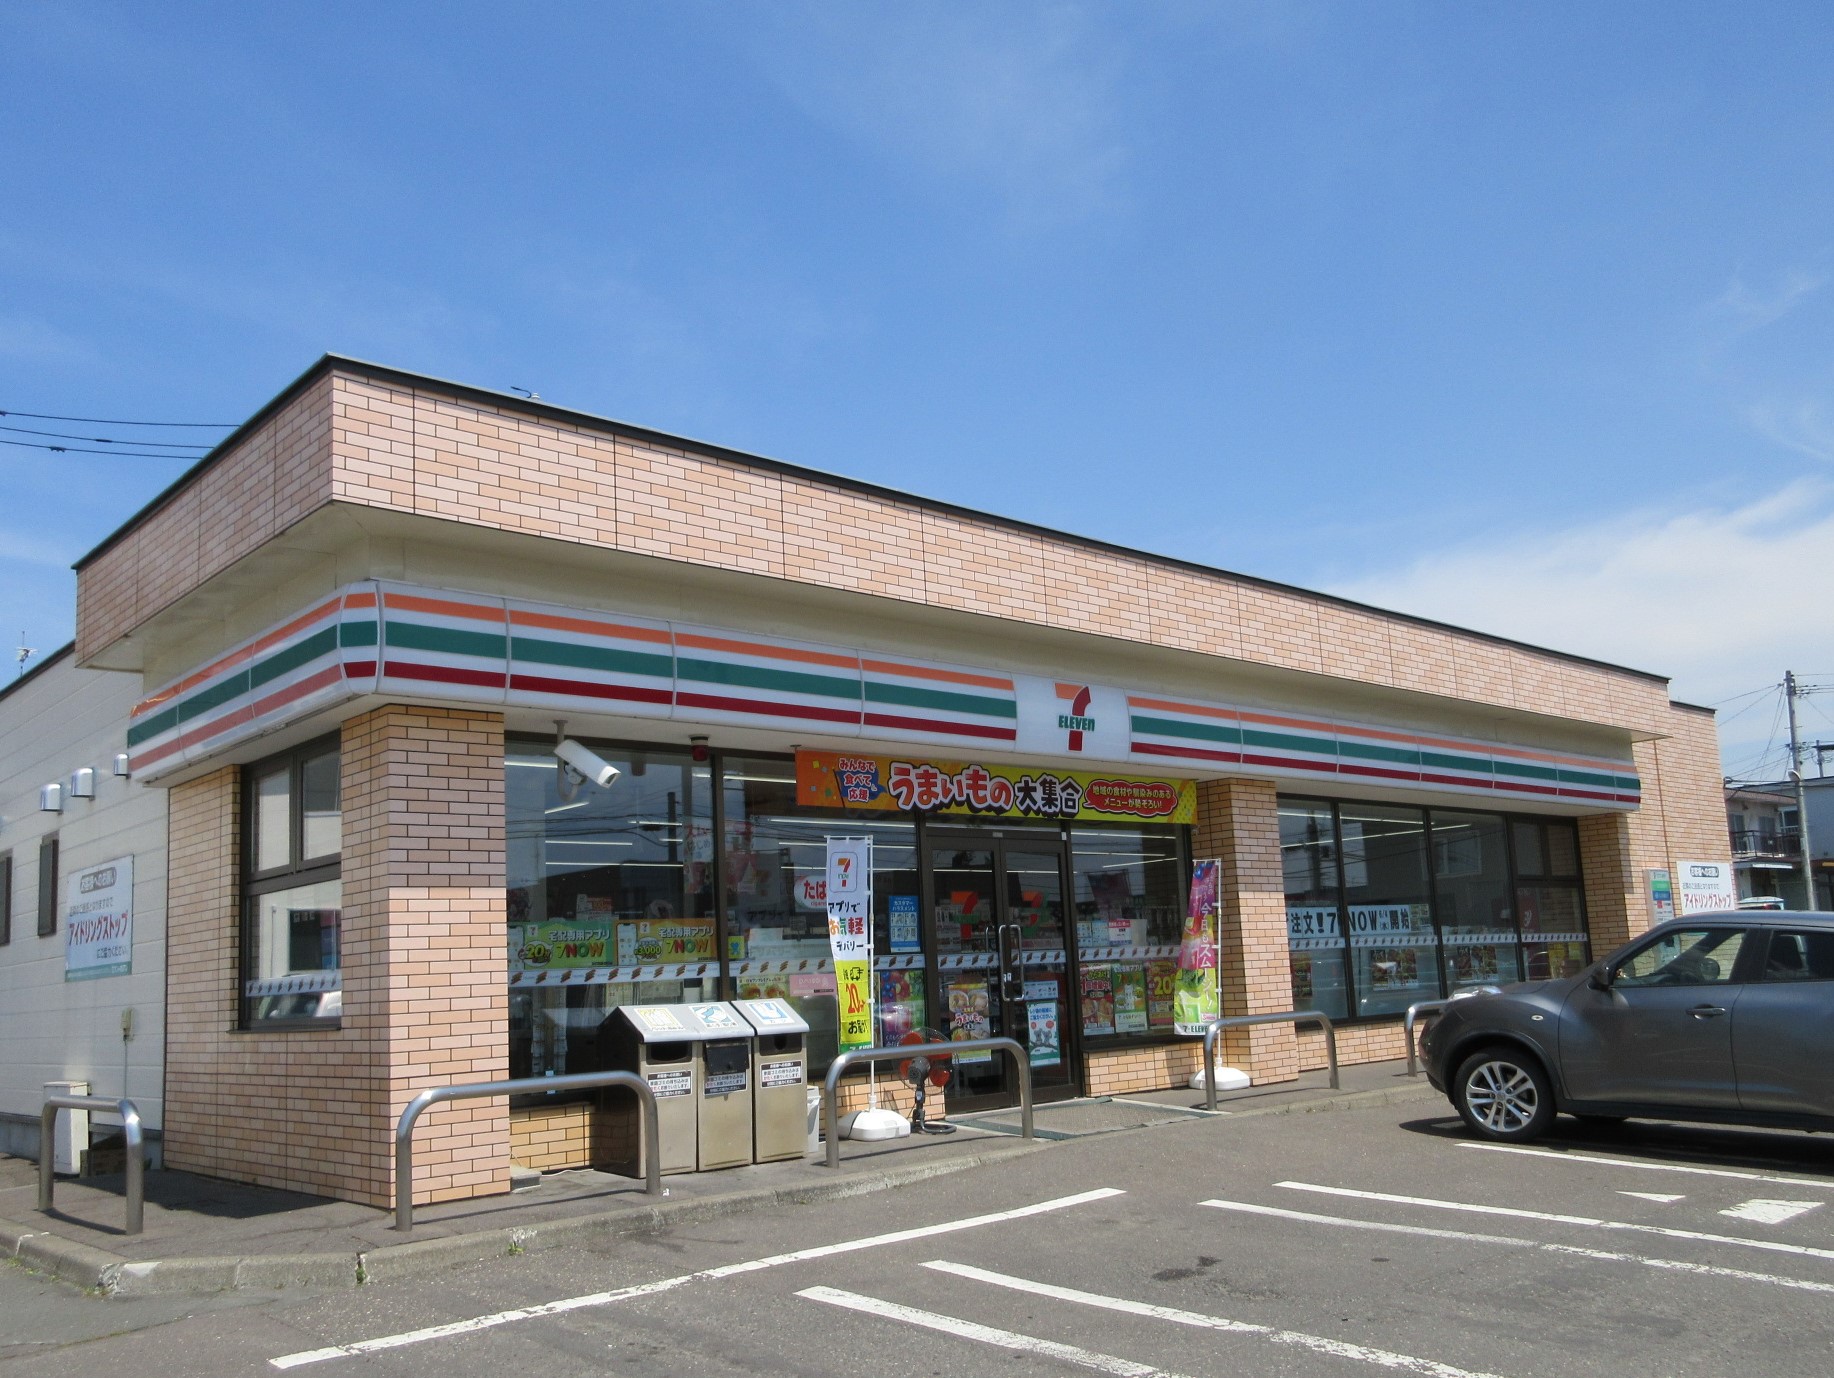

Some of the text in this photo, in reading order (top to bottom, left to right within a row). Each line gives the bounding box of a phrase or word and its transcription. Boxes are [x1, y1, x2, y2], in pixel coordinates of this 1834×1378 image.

[1055, 682, 1091, 751] 7
[839, 758, 876, 773] みんなで
[844, 774, 872, 787] 食べて
[848, 788, 870, 802] 応援
[1684, 893, 1731, 908] アイドリングストップ
[69, 911, 128, 946] アイドリングストップ
[657, 926, 714, 939] 宅配専用アプリ
[828, 917, 864, 936] お気軽
[549, 929, 610, 942] 宅配専用アプリ
[557, 942, 605, 959] 7NOW
[666, 939, 709, 954] 7NOW
